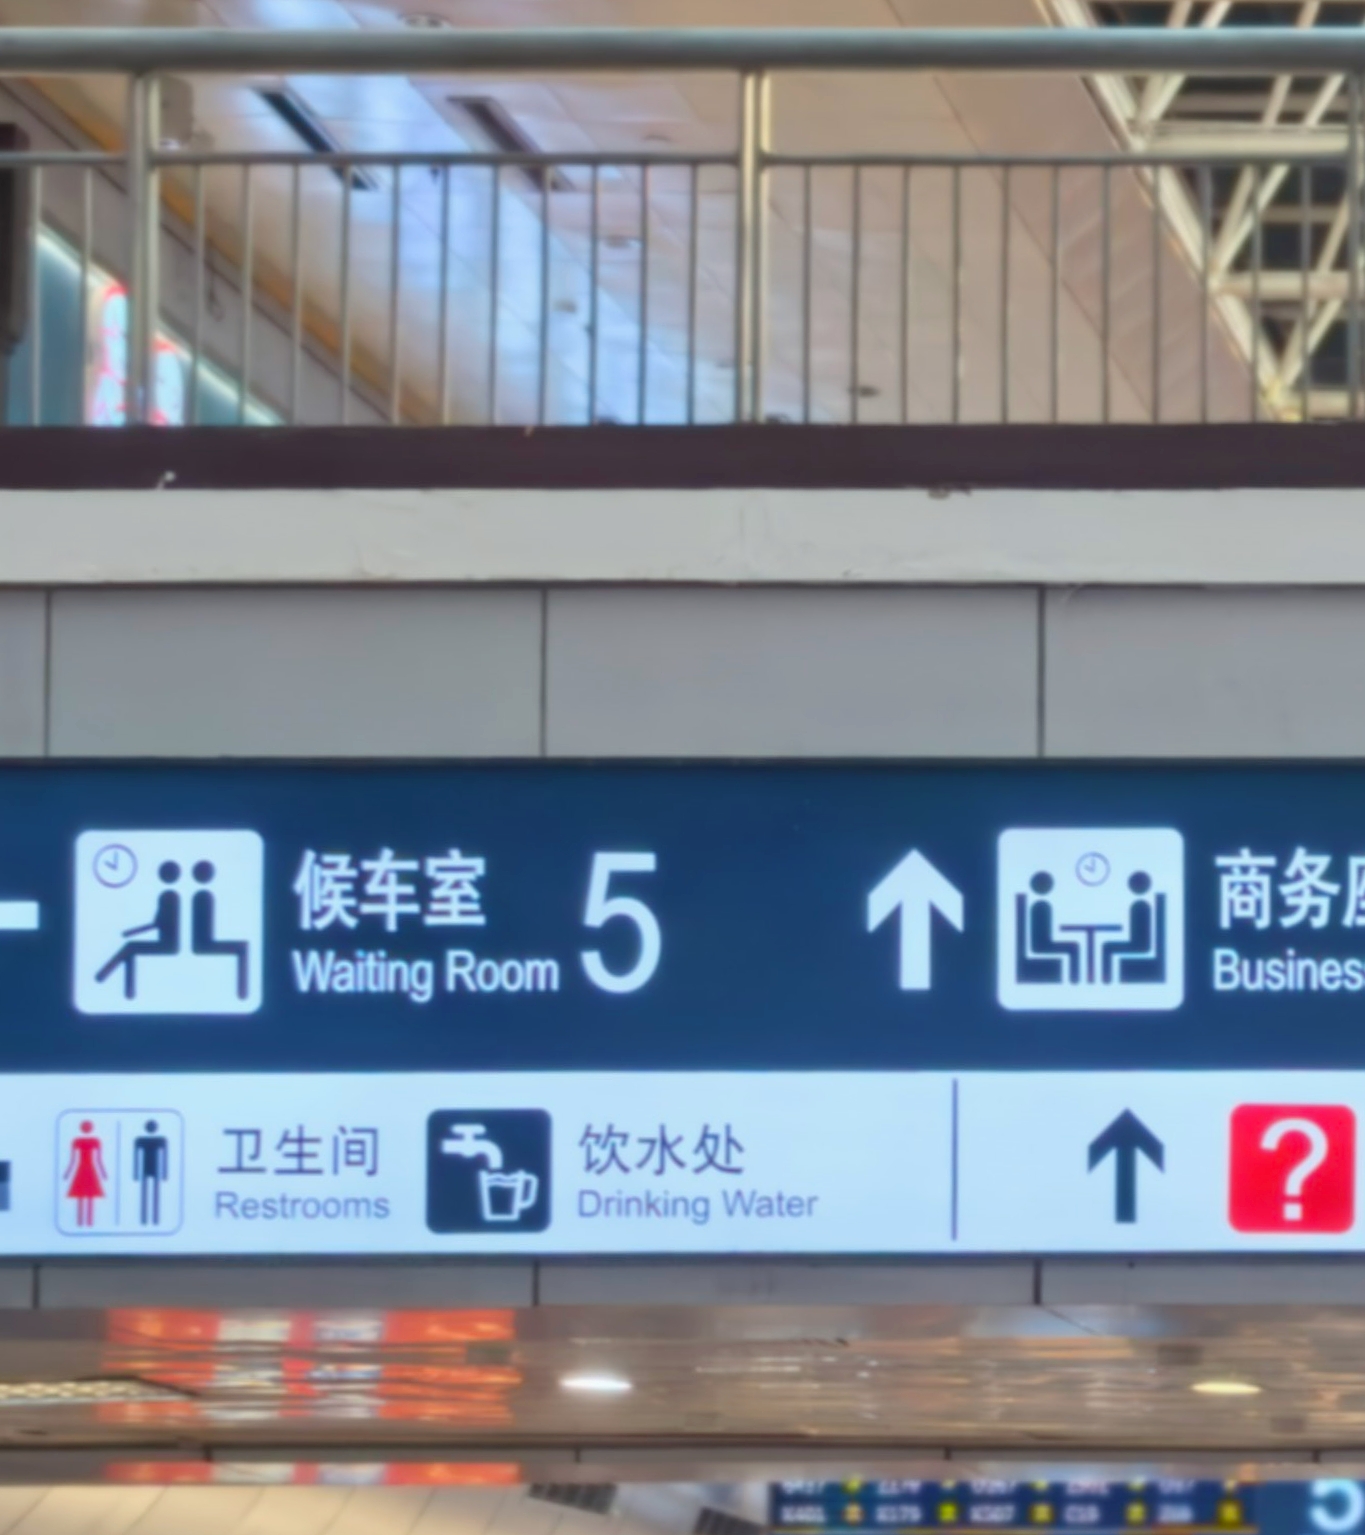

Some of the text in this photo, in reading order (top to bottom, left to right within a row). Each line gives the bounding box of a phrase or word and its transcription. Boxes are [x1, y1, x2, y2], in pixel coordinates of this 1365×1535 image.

[292, 847, 486, 933] 候车室
[580, 851, 662, 994] 5
[291, 948, 560, 1004] Waiting Room
[217, 1124, 379, 1178] 卫生间
[578, 1123, 744, 1177] 饮水处
[214, 1190, 391, 1221] Restrooms
[577, 1188, 819, 1226] Drinking Water
